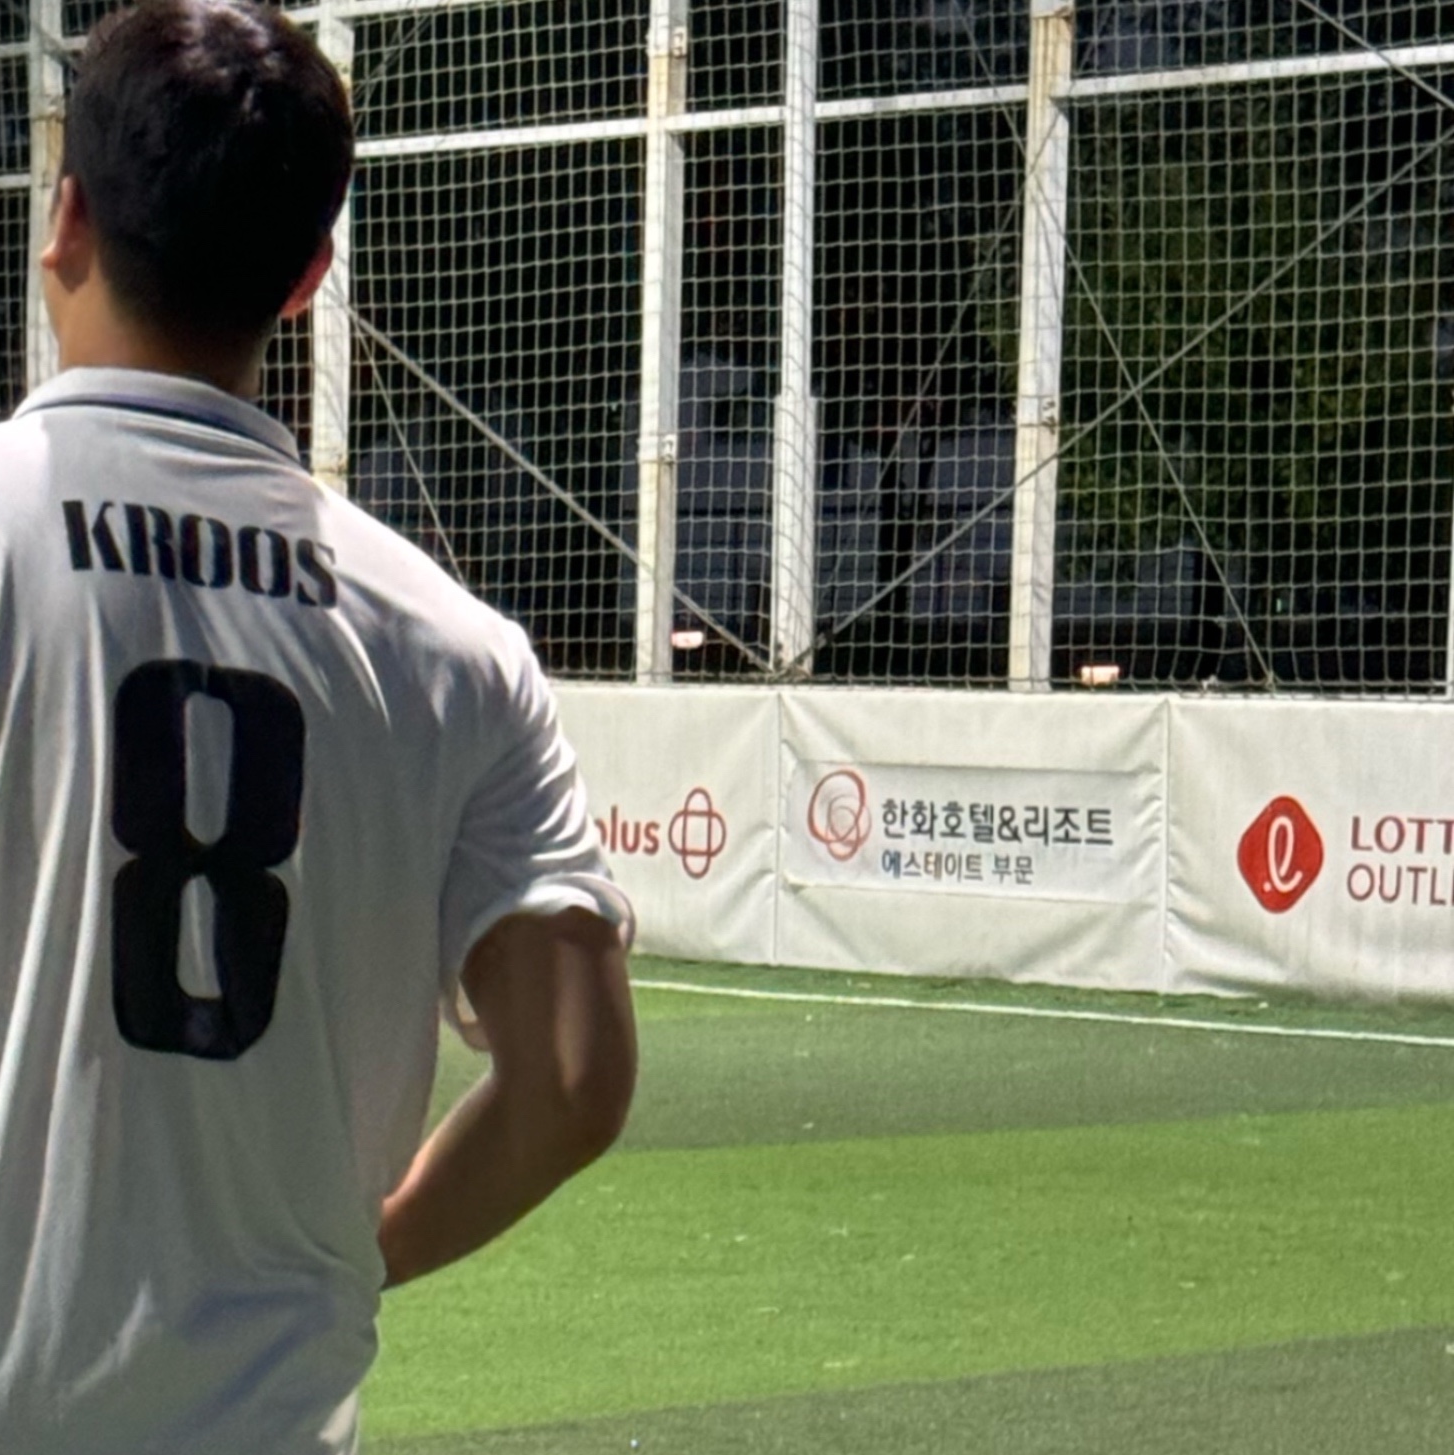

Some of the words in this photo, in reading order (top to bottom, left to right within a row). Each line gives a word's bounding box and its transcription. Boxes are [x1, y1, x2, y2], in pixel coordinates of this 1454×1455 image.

[62, 499, 339, 608] KROOS
[881, 797, 1114, 847] 한화호텔&리조트
[111, 657, 306, 1062] 8
[881, 849, 984, 882] 에스테이트
[992, 853, 1035, 885] 부문
[1347, 863, 1454, 906] OUTL
